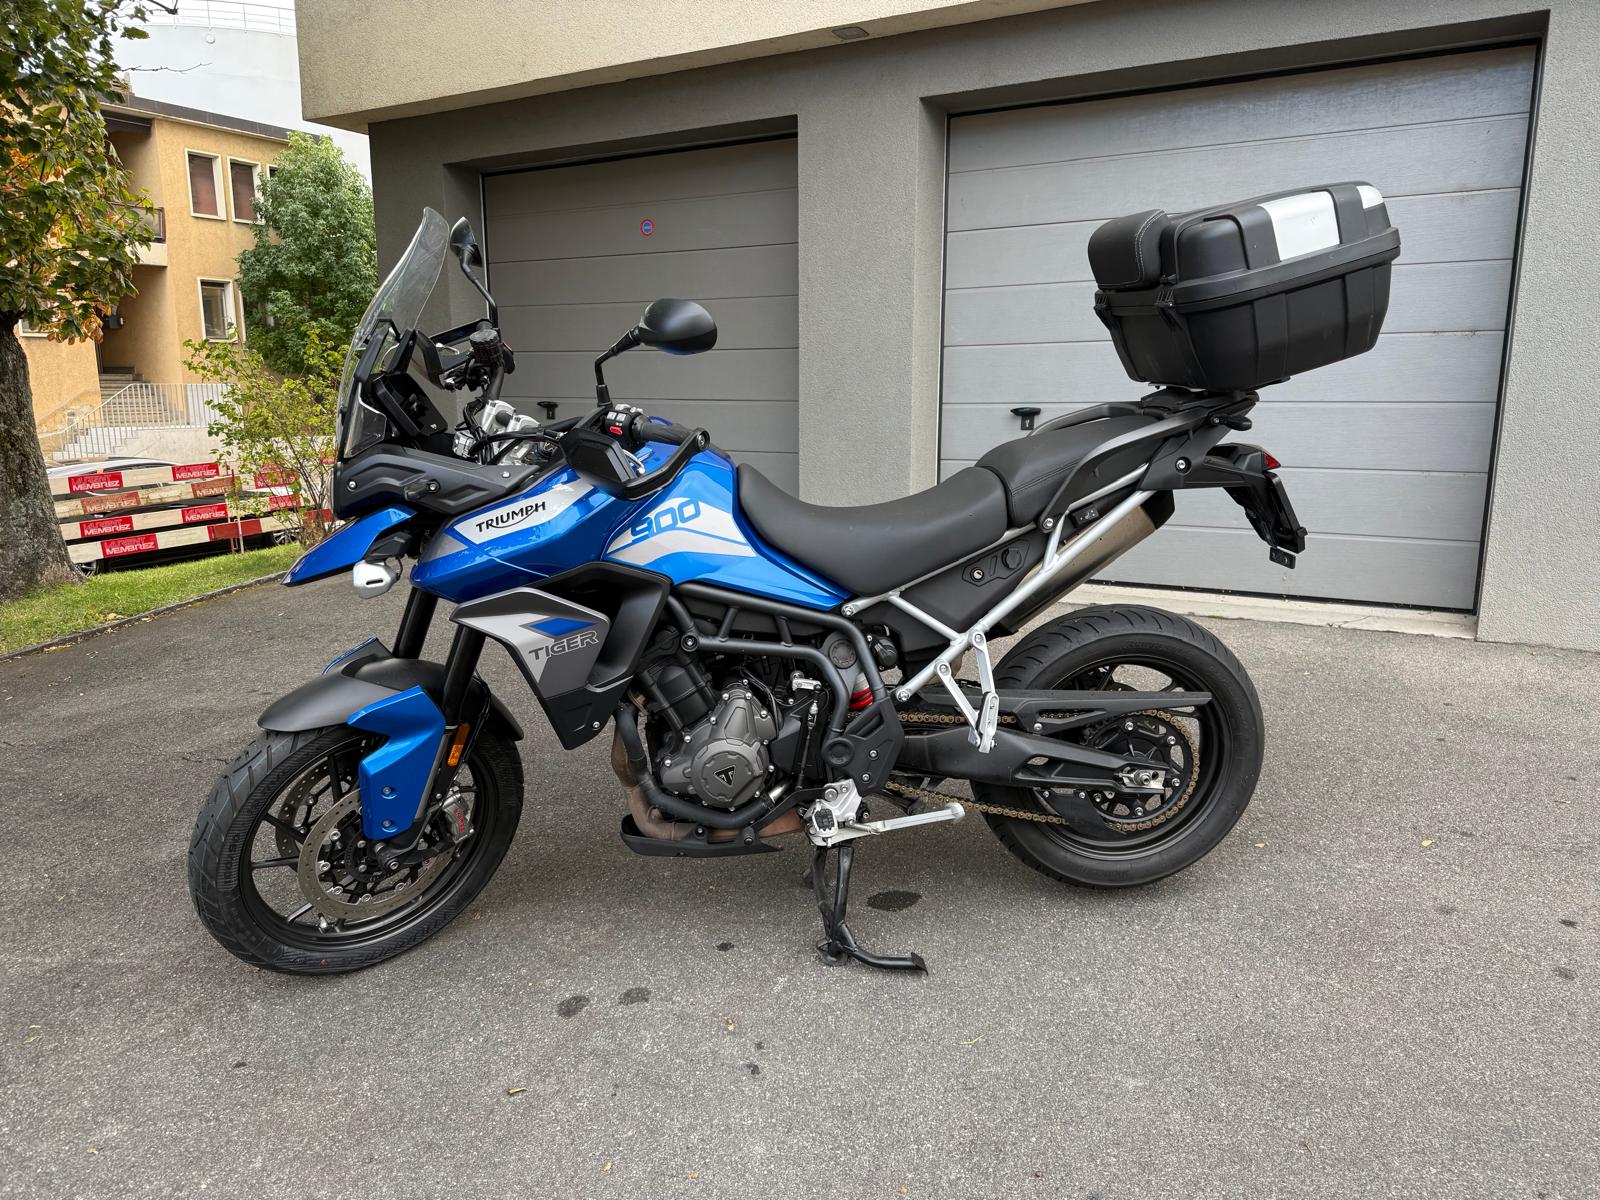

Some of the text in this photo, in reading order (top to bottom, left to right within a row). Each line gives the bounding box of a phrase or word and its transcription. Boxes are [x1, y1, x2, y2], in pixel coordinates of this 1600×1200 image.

[72, 480, 120, 491] MEMBREZ
[185, 510, 226, 522] MEMBREZ
[476, 501, 546, 533] TRIUMPH
[630, 500, 701, 542] 900
[84, 523, 131, 536] MEMBREZ
[105, 541, 156, 556] MEMBREZ
[528, 630, 600, 661] TIGER
